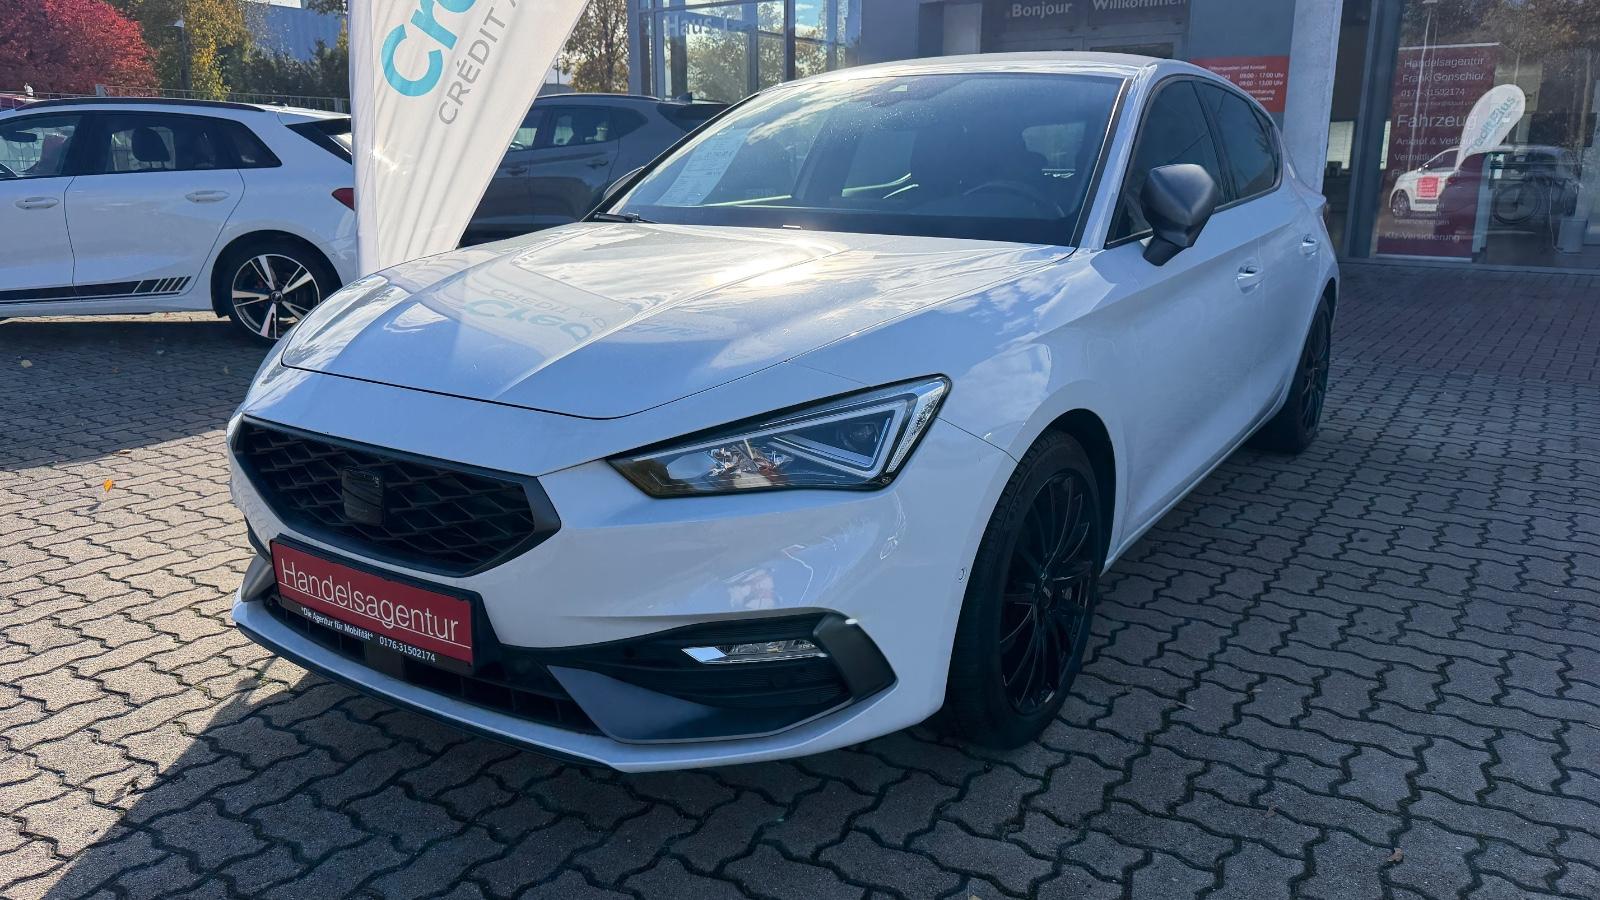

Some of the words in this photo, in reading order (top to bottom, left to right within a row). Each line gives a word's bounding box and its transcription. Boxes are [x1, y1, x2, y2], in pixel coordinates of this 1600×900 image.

[1012, 2, 1073, 19] Bonjour
[381, 0, 477, 97] cr
[439, 6, 506, 125] CRÉDIT
[1403, 57, 1485, 68] Handelsagentur
[281, 558, 459, 641] Handelsagentur
[379, 636, 436, 663] 0176-31502174
